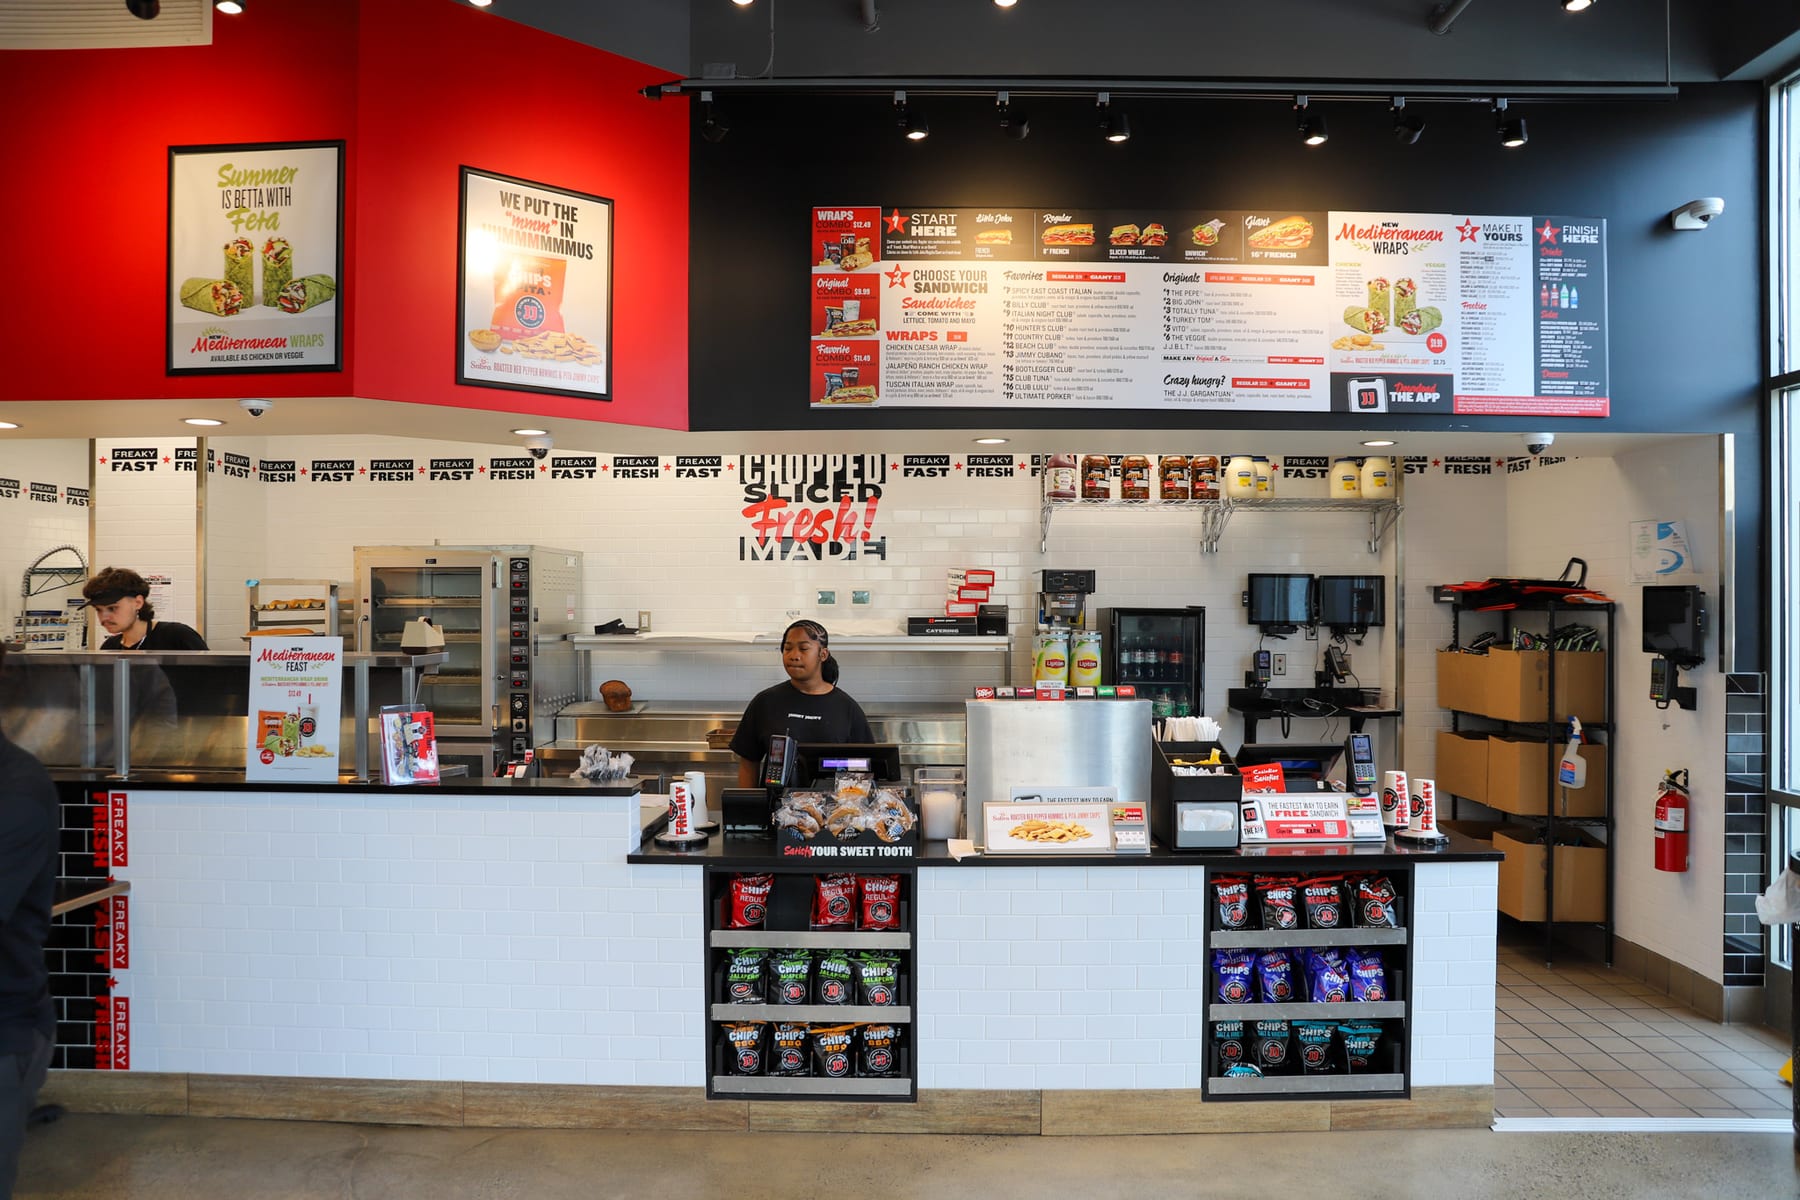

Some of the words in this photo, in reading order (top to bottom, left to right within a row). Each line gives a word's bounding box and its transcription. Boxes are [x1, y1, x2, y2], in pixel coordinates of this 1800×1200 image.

[218, 164, 298, 187] Summer
[222, 189, 231, 209] IS
[234, 188, 263, 208] BETTA
[266, 186, 291, 206] WITH
[500, 190, 521, 211] WE
[524, 196, 550, 217] PUT
[553, 203, 578, 223] THE
[225, 207, 280, 233] Feta
[817, 211, 854, 221] WRAPS
[911, 213, 957, 225] START
[1043, 213, 1072, 224] Regular
[1245, 216, 1270, 230] Giant
[561, 221, 574, 239] IN
[911, 225, 957, 237] HERE
[1335, 222, 1443, 242] Mediterranean
[1483, 224, 1511, 234] MAKE
[1513, 224, 1523, 233] IT
[1563, 226, 1599, 236] FINISH
[1484, 234, 1523, 242] YOURS
[1562, 234, 1599, 243] HERE
[1373, 241, 1409, 255] WRAPS
[1264, 251, 1297, 259] FRENCH
[913, 270, 956, 281] CHOOSE
[959, 270, 988, 282] YOUR
[1003, 271, 1043, 281] Favorites
[1163, 272, 1200, 285] Originals
[817, 278, 849, 289] Original
[914, 282, 989, 294] SANDWICH
[816, 289, 851, 297] COMBO
[1031, 287, 1047, 295] EAST
[1048, 287, 1067, 295] COAST
[1069, 287, 1093, 295] ITALIAN
[1171, 289, 1183, 297] THE
[902, 297, 977, 310] Sandwiches
[1011, 310, 1035, 318] ITALIAN
[1172, 316, 1198, 324] TURKEY
[886, 331, 938, 341] WRAPS
[1014, 334, 1044, 342] COUNTRY
[1171, 334, 1184, 342] THE
[191, 335, 288, 353] Mediterranean
[289, 333, 325, 349] WRAPS
[1015, 342, 1036, 350] BEACH
[816, 344, 850, 354] Favorite
[210, 353, 240, 362] AVAILABLE
[241, 353, 248, 361] AS
[249, 352, 274, 361] CHICKEN
[275, 352, 283, 360] OR
[284, 351, 305, 360] VEGGIE
[816, 354, 851, 362] COMBO
[1015, 351, 1036, 359] JIMMY
[1015, 374, 1032, 382] CLUB
[1163, 374, 1190, 388] Crazy
[1191, 374, 1226, 389] hungry?
[886, 381, 911, 389] TUSCAN
[912, 381, 935, 389] ITALIAN
[936, 381, 955, 389] WRAP
[1015, 392, 1045, 400] ULTIMATE
[1390, 392, 1415, 402] THE
[1416, 393, 1440, 402] APP
[115, 452, 155, 461] FREAKY
[616, 458, 656, 466] FREAKY
[679, 457, 719, 465] FREAKY
[906, 457, 947, 465] FREAKY
[970, 457, 1011, 465] FREAKY
[1286, 458, 1326, 466] FREAKY
[112, 460, 158, 472] FAST
[225, 457, 249, 468] FREAKY
[262, 463, 293, 471] FREAKY
[314, 462, 352, 470] FREAKY
[373, 461, 411, 469] FREAKY
[432, 460, 471, 468] FREAKY
[493, 460, 532, 468] FREAKY
[555, 459, 594, 467] FREAKY
[1507, 460, 1531, 474] FAST
[224, 466, 249, 479] FAST
[430, 469, 473, 480] FAST
[490, 469, 534, 480] FRESH
[552, 468, 596, 479] FAST
[613, 467, 658, 478] FRESH
[676, 466, 721, 478] FAST
[740, 454, 886, 484] CHOPPED
[904, 467, 950, 478] FAST
[967, 467, 1013, 478] FRESH
[1283, 468, 1329, 479] FAST
[1444, 463, 1490, 475] FRESH
[260, 471, 295, 482] FRESH
[312, 471, 354, 482] FAST
[370, 470, 413, 481] FRESH
[31, 483, 57, 494] FREAKY
[744, 482, 883, 503] SLICED
[30, 492, 57, 503] FRESH
[742, 494, 880, 545] Fresh!
[740, 536, 886, 561] MADE
[257, 648, 335, 662] Mediterranean
[286, 661, 308, 672] FEAST
[1046, 660, 1065, 668] Lipton
[1079, 660, 1097, 668] Lipton
[1396, 774, 1408, 824] FREAKY
[1268, 802, 1279, 810] THE
[1279, 802, 1302, 810] FASTEST
[1316, 801, 1323, 809] TO
[1323, 801, 1338, 809] EARN
[1275, 809, 1309, 817] FREE
[1310, 809, 1339, 817] SANDWICH
[94, 792, 109, 867] FRESH
[114, 798, 124, 862] FREAKY
[811, 846, 838, 857] YOUR
[839, 846, 876, 857] SWEET
[876, 846, 912, 857] TOOTH
[866, 882, 897, 895] CHIPS
[1218, 883, 1247, 896] CHIPS
[1305, 884, 1337, 896] CHIPS
[115, 900, 126, 965] FREAKY
[729, 963, 760, 974] CHIPS
[779, 963, 809, 975] CHIPS
[821, 959, 851, 976] CHIPS
[862, 966, 893, 978] CHIPS
[1220, 965, 1250, 976] CHIPS
[1356, 966, 1384, 979] CHIPS
[1256, 1020, 1288, 1031] CHIPS
[117, 1001, 126, 1066] FREAKY
[729, 1030, 759, 1041] CHIPS
[774, 1030, 805, 1041] CHIPS
[863, 1030, 894, 1040] CHIPS
[820, 1035, 851, 1046] CHIPS
